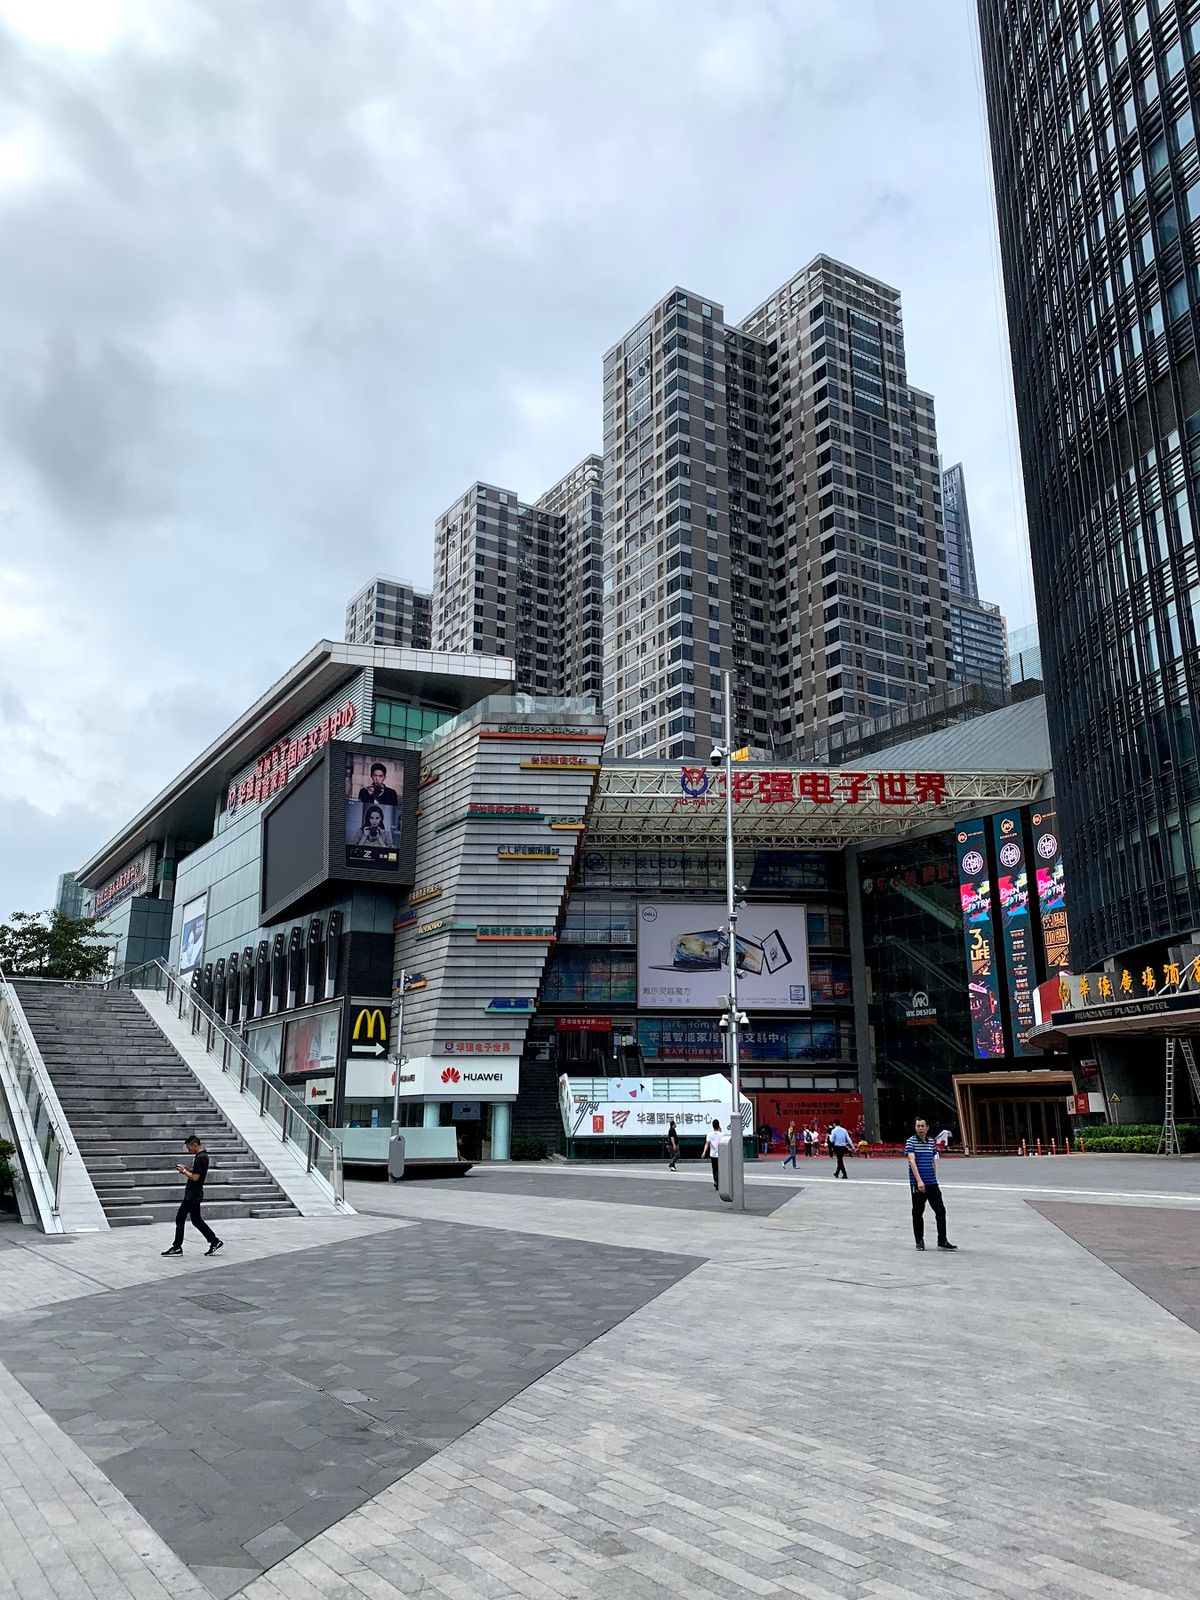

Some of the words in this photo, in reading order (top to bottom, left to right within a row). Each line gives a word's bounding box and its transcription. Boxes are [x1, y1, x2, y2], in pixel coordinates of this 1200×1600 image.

[718, 770, 949, 805] 华强电子世界
[970, 948, 990, 961] LIFE
[1075, 1008, 1113, 1020] HUAQIANG
[1114, 1004, 1141, 1015] PLAZA
[1143, 1001, 1170, 1012] HOTEL
[456, 1042, 511, 1053] 华强电子世界
[463, 1073, 503, 1081] HUAWEI
[637, 1112, 713, 1125] 华强国际创客中心
